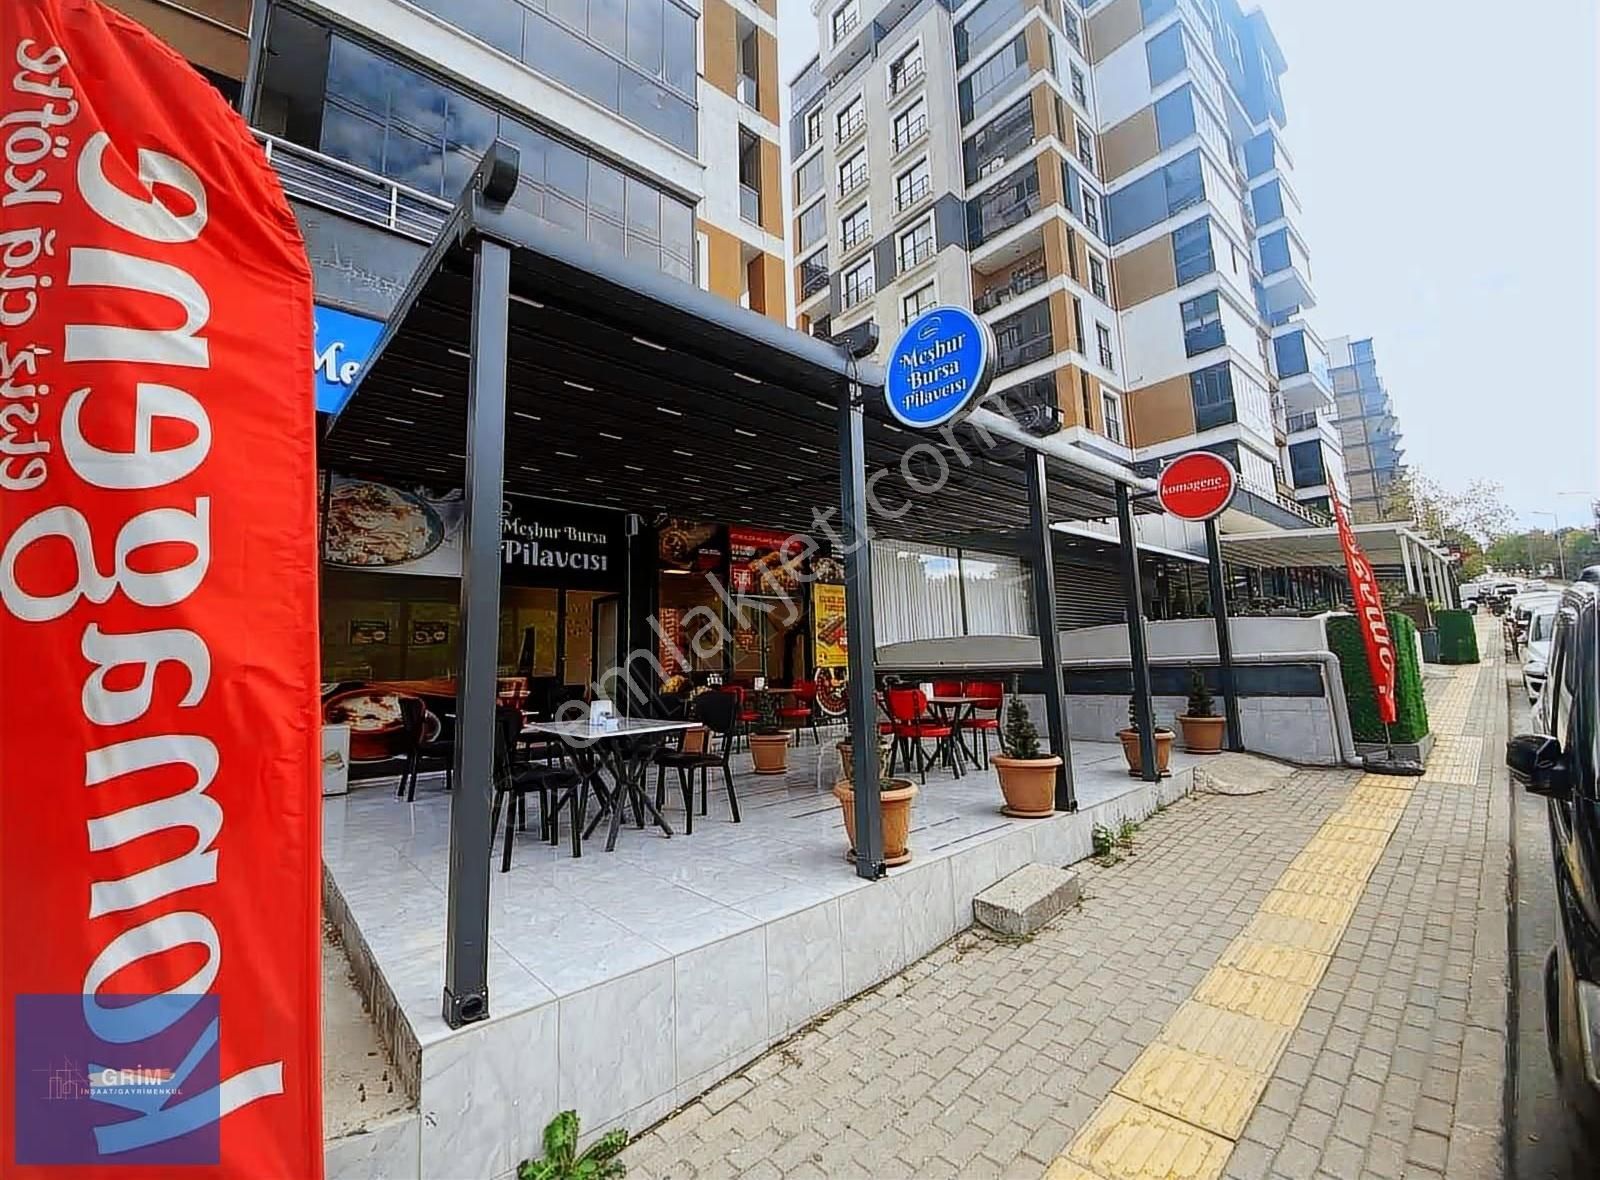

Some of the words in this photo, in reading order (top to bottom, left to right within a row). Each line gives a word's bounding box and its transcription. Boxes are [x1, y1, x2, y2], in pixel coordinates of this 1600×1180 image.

[899, 333, 967, 370] Meşhur
[907, 361, 959, 391] Bursa
[1161, 477, 1222, 497] komagene
[500, 517, 561, 540] Meşhur
[564, 526, 607, 544] Bursa
[500, 540, 607, 571] Pilavcısı
